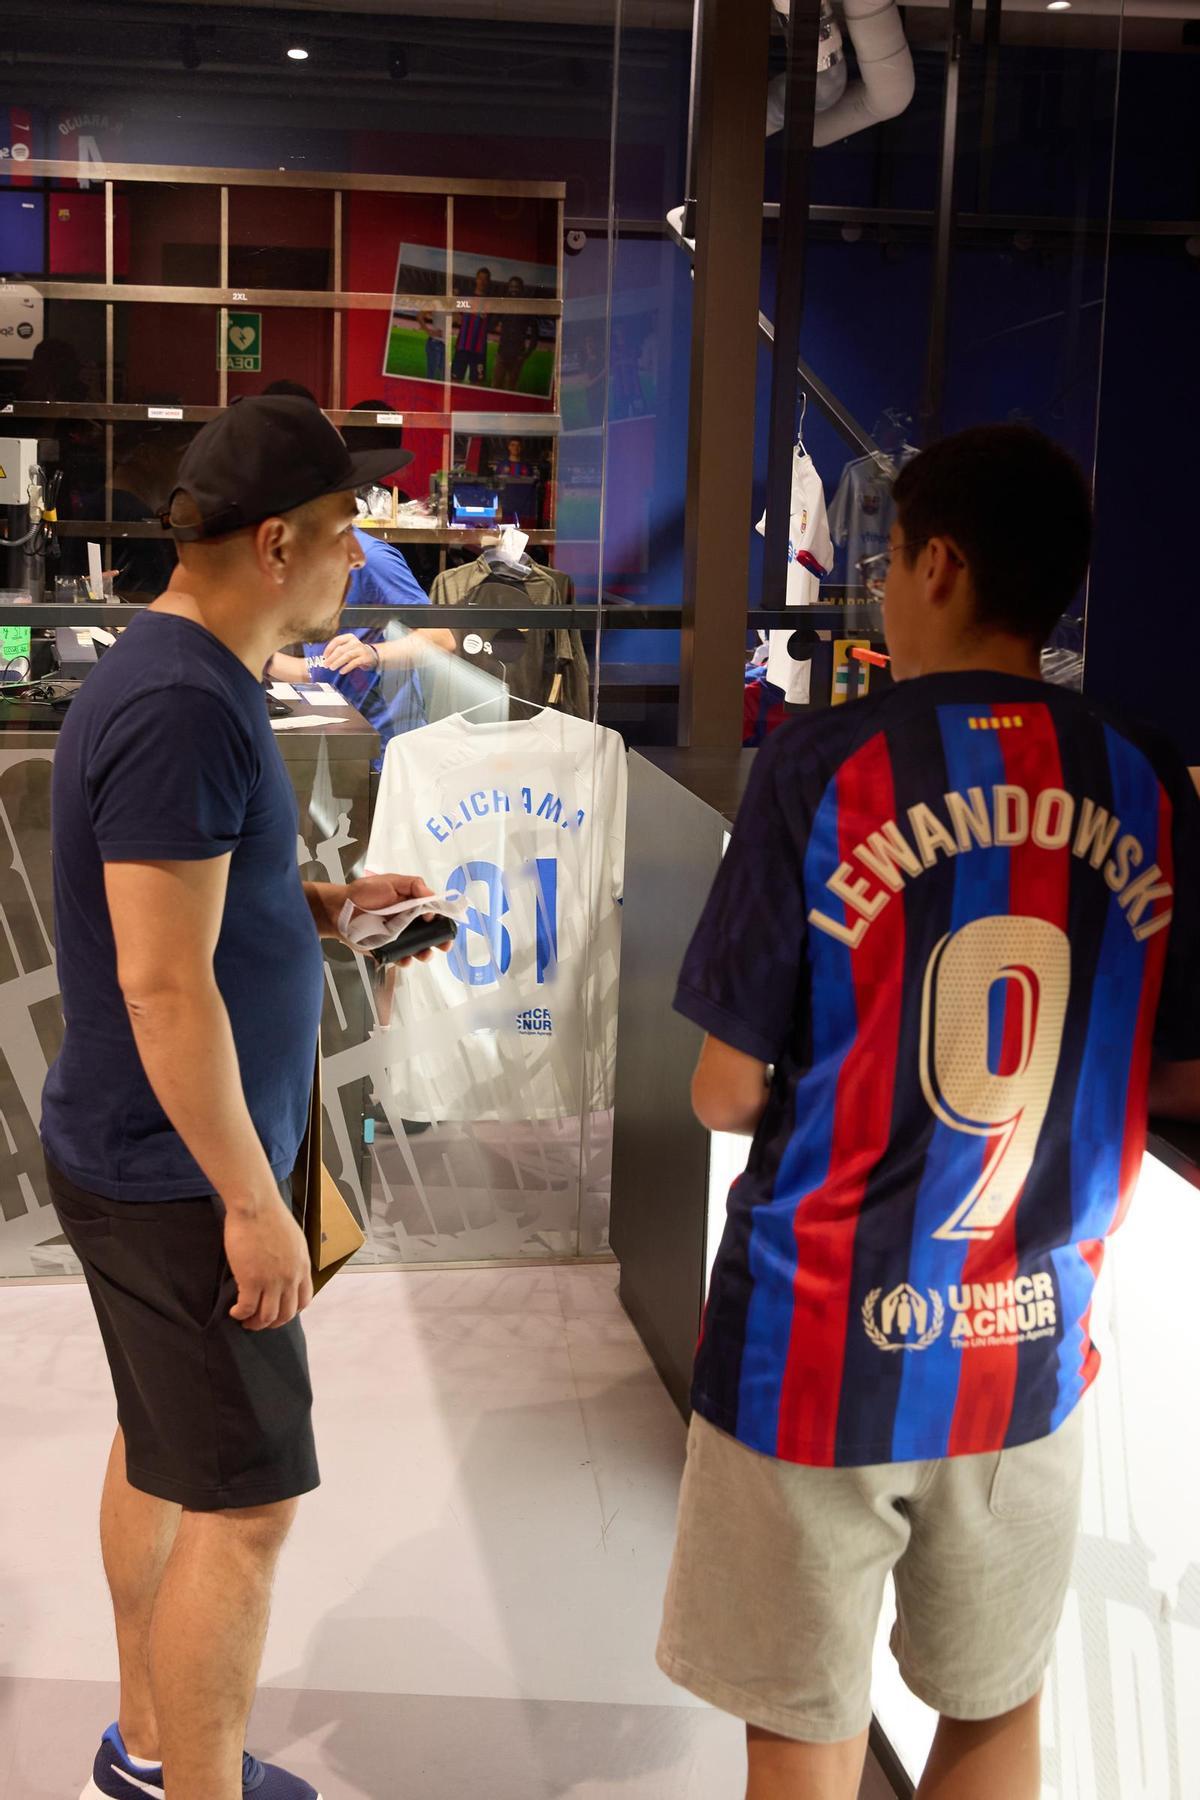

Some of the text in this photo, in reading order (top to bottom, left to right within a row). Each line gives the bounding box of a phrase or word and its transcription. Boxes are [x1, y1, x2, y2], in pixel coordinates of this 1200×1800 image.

[232, 292, 248, 301] 2XL
[456, 300, 471, 309] 2XL
[807, 784, 1174, 950] LEWANDOWSKI
[445, 857, 558, 986] 81
[516, 1008, 552, 1019] HCR
[919, 914, 1071, 1241] 9
[947, 1271, 1055, 1312] UNHCR
[950, 1298, 1057, 1338] ACNUR
